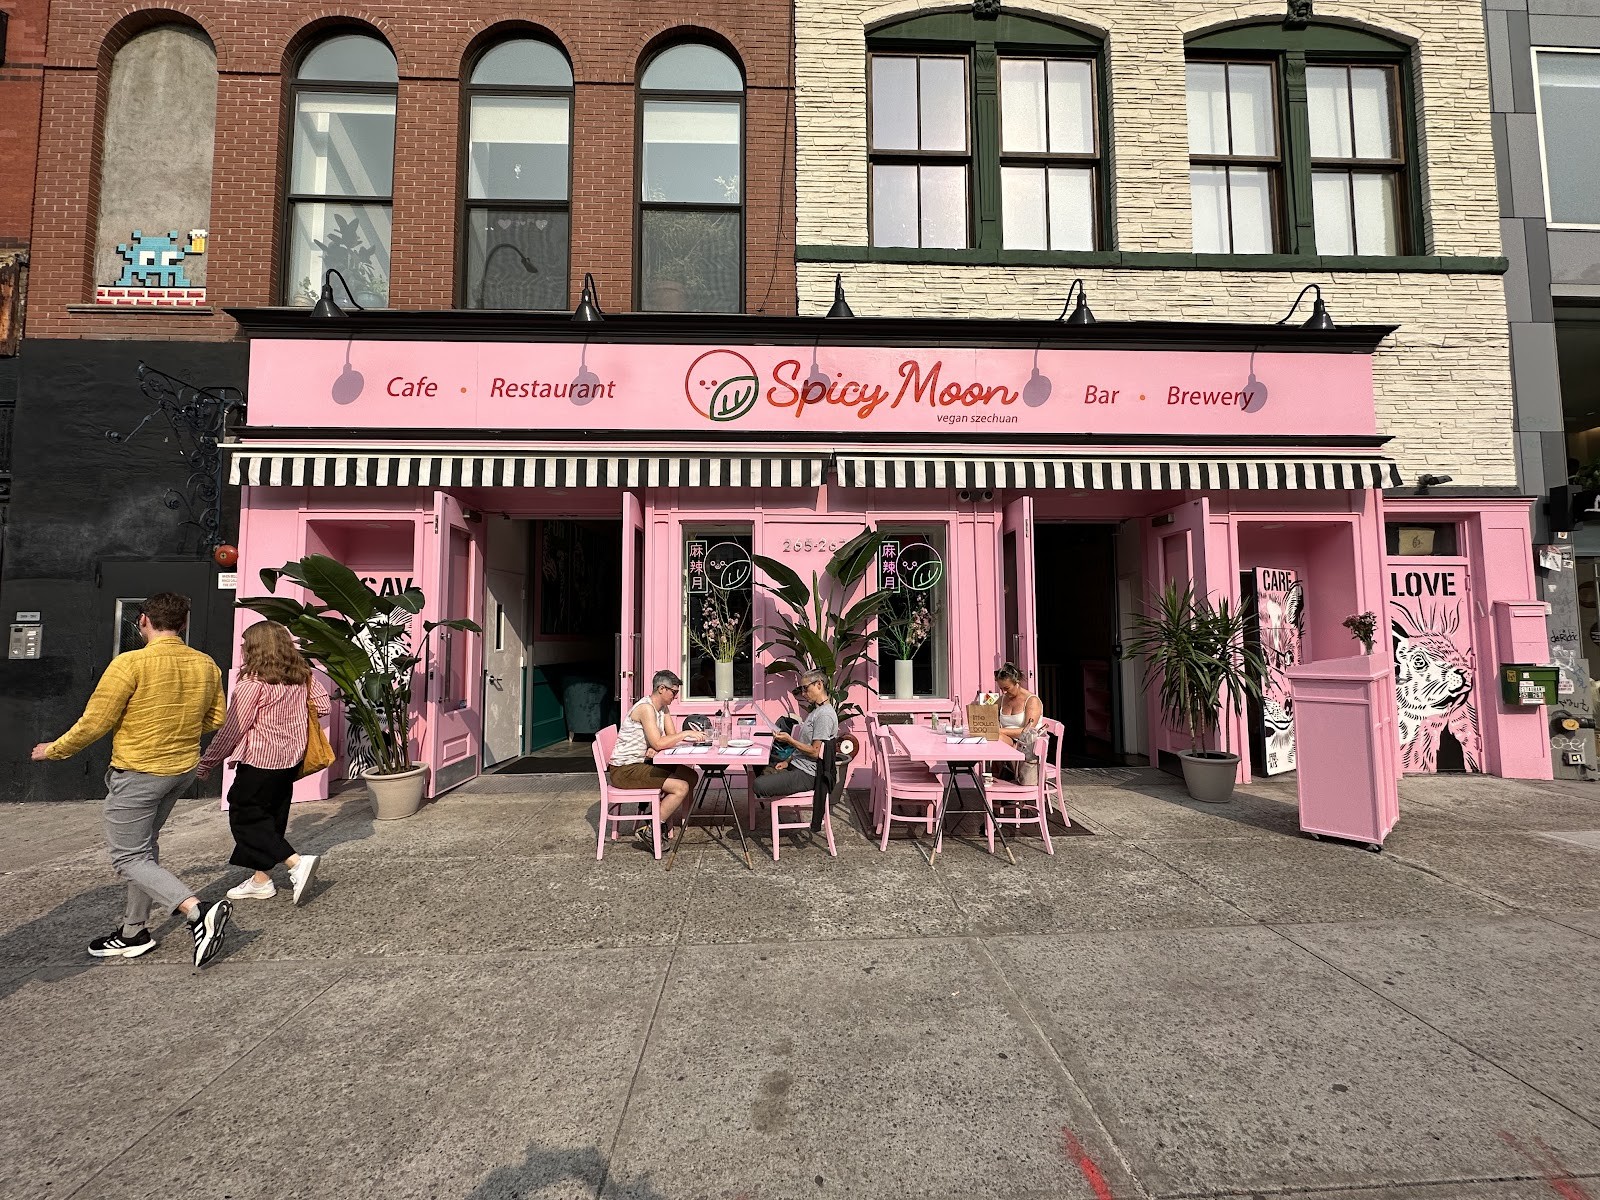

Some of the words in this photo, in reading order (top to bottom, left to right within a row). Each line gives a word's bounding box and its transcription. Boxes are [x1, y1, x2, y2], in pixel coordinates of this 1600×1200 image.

[386, 376, 438, 398] Cafe
[490, 377, 617, 399] Restaurant
[767, 358, 890, 419] Spicy
[890, 358, 1020, 409] Moon
[1084, 384, 1120, 405] Bar
[1167, 385, 1254, 411] Brewery
[937, 414, 968, 425] vegan
[970, 413, 1018, 423] szechuan
[689, 543, 704, 590] 麻辣月
[881, 544, 896, 589] 麻辣月
[1263, 569, 1291, 592] CARE
[1390, 572, 1457, 597] LOVE
